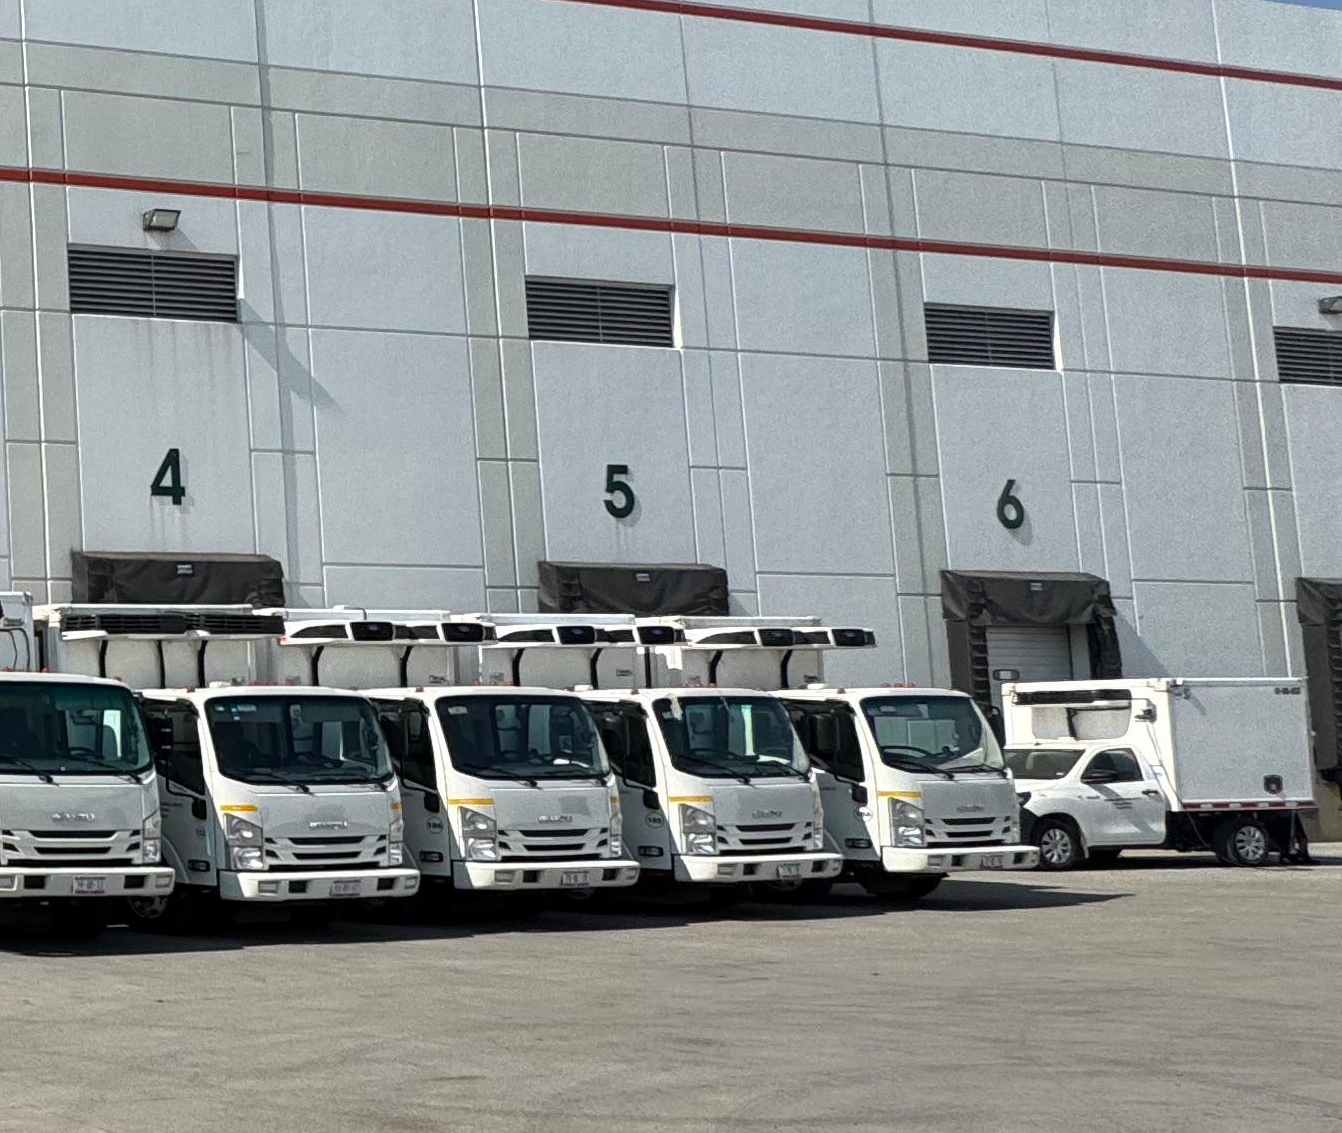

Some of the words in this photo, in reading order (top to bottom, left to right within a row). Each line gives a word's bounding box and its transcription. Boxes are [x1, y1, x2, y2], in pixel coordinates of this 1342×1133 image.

[150, 448, 186, 506] 4
[604, 464, 635, 519] 5
[997, 479, 1025, 530] 6
